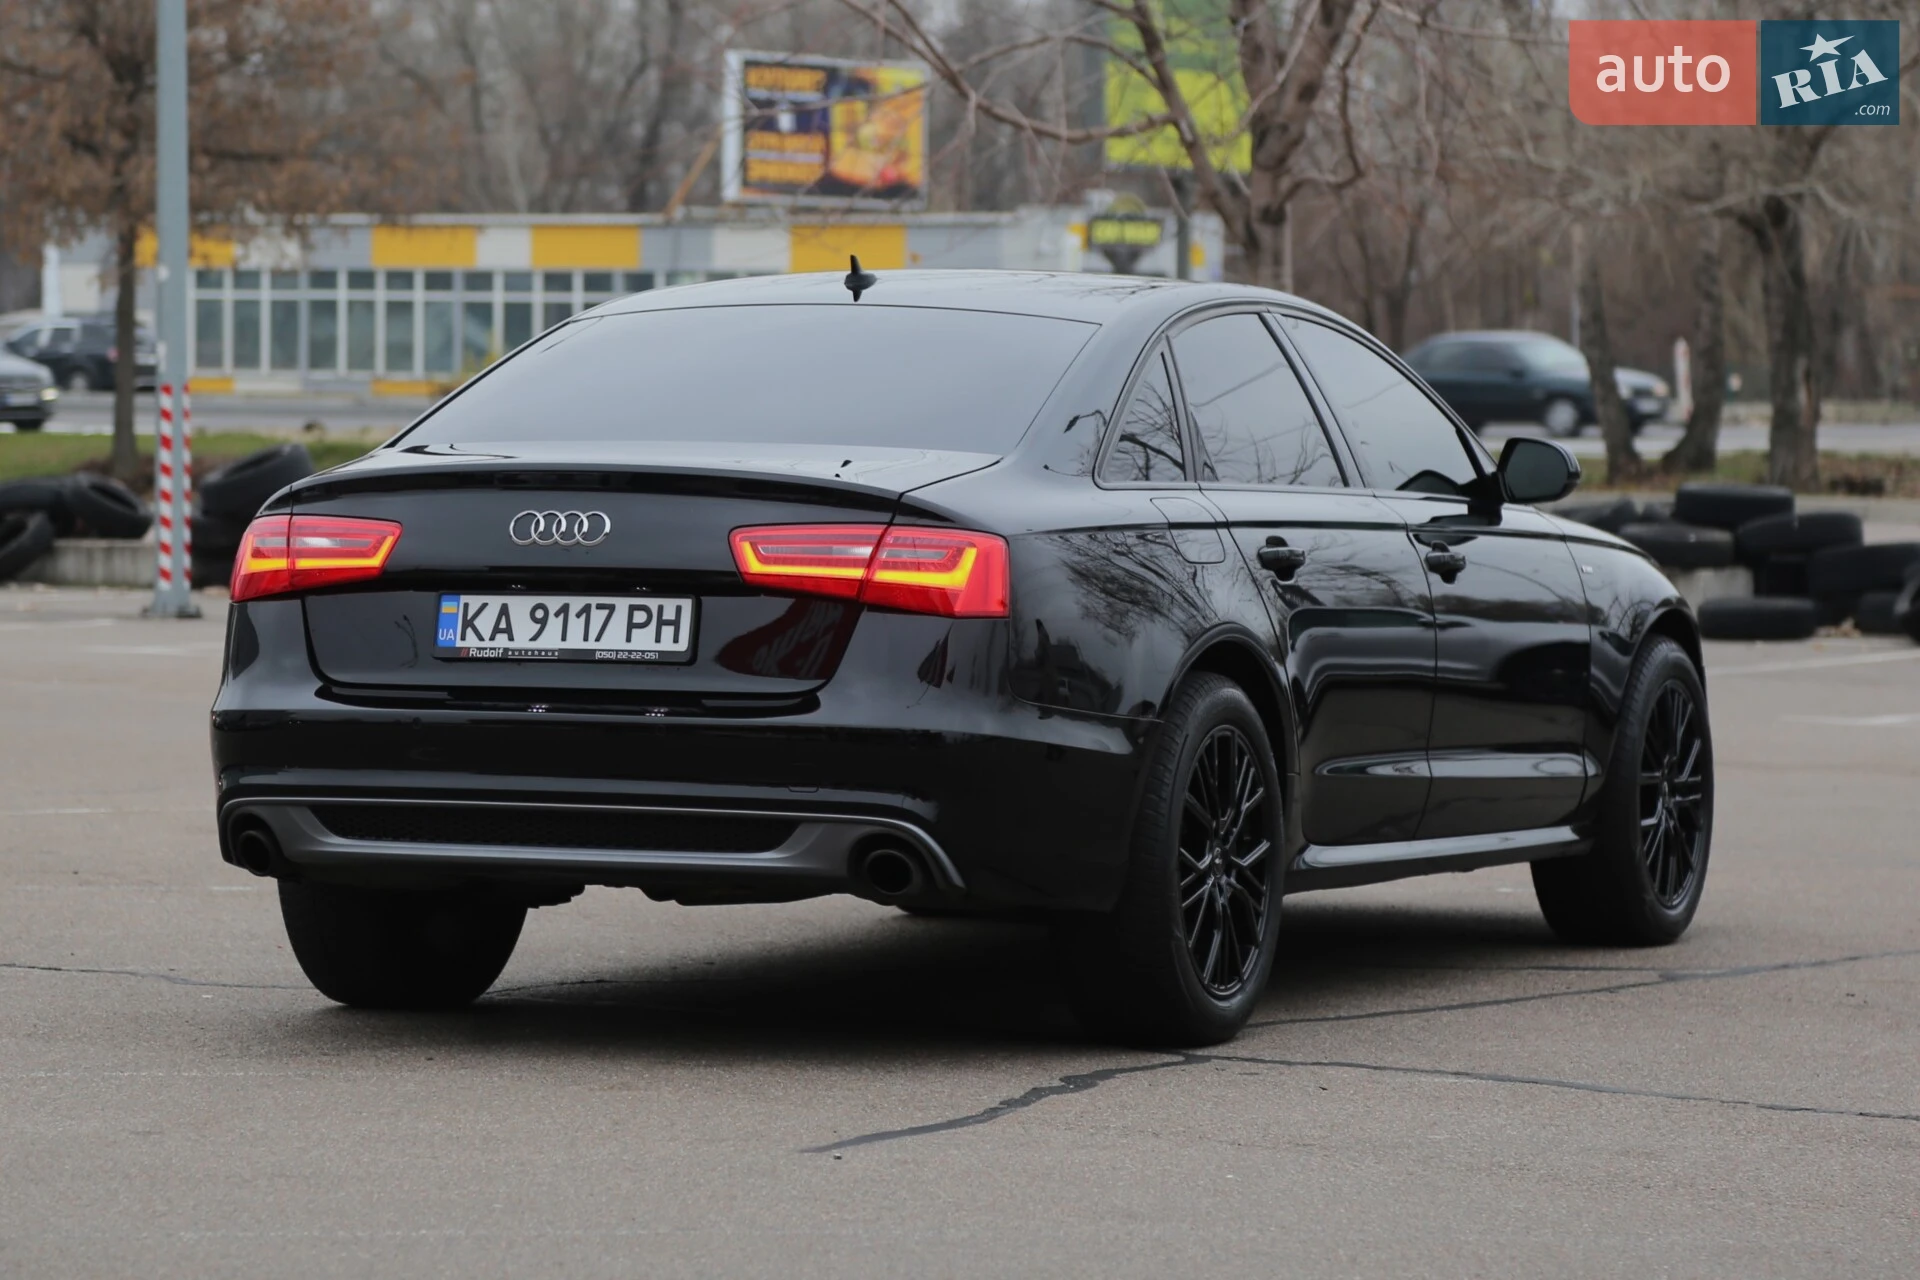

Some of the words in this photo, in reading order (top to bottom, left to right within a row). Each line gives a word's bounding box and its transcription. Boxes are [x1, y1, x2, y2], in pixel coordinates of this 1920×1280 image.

[460, 602, 515, 642] KA
[528, 602, 616, 643] 9117
[625, 603, 682, 644] PH
[438, 628, 455, 641] UA
[469, 647, 504, 657] Rudolf
[595, 650, 616, 660] (050)
